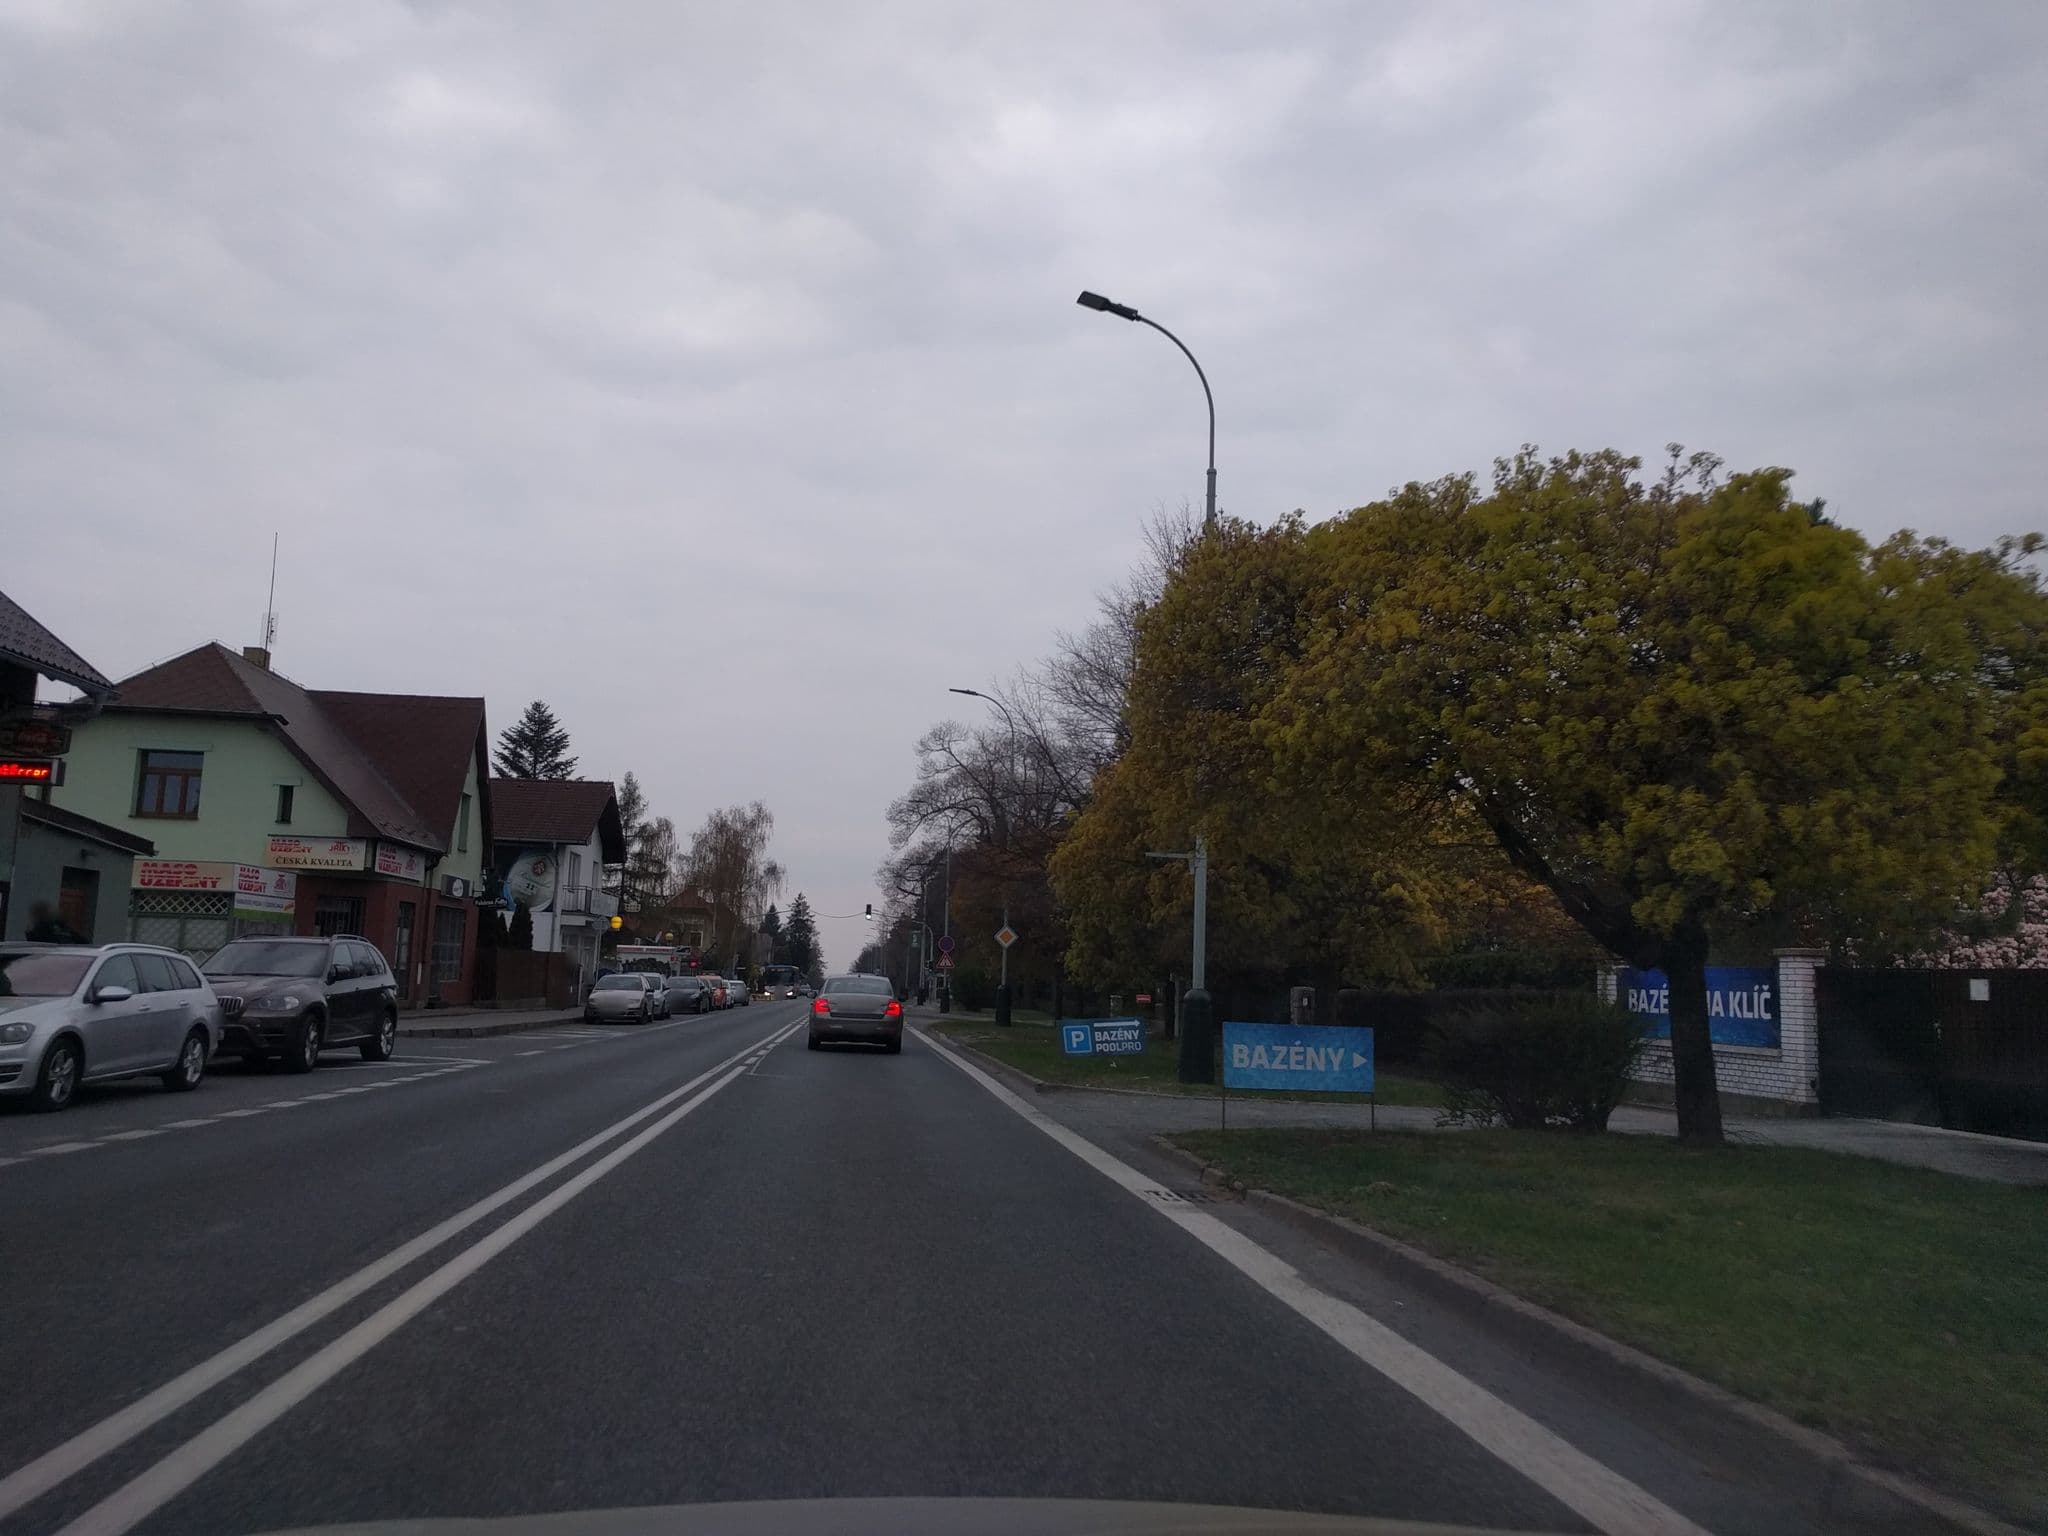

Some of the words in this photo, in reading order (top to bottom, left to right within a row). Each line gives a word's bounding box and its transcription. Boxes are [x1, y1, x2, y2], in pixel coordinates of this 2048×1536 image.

[275, 855, 308, 866] ČESKÁ
[310, 858, 352, 867] KVALITA
[141, 862, 198, 876] MASO
[1628, 983, 1670, 1015] BAZÉ
[1729, 984, 1772, 1020] KLÍČ
[1071, 1030, 1085, 1049] P
[1094, 1028, 1140, 1042] BAZÉNY
[1096, 1042, 1143, 1053] POOLPRO
[1232, 1040, 1345, 1072] BAZÉNY
